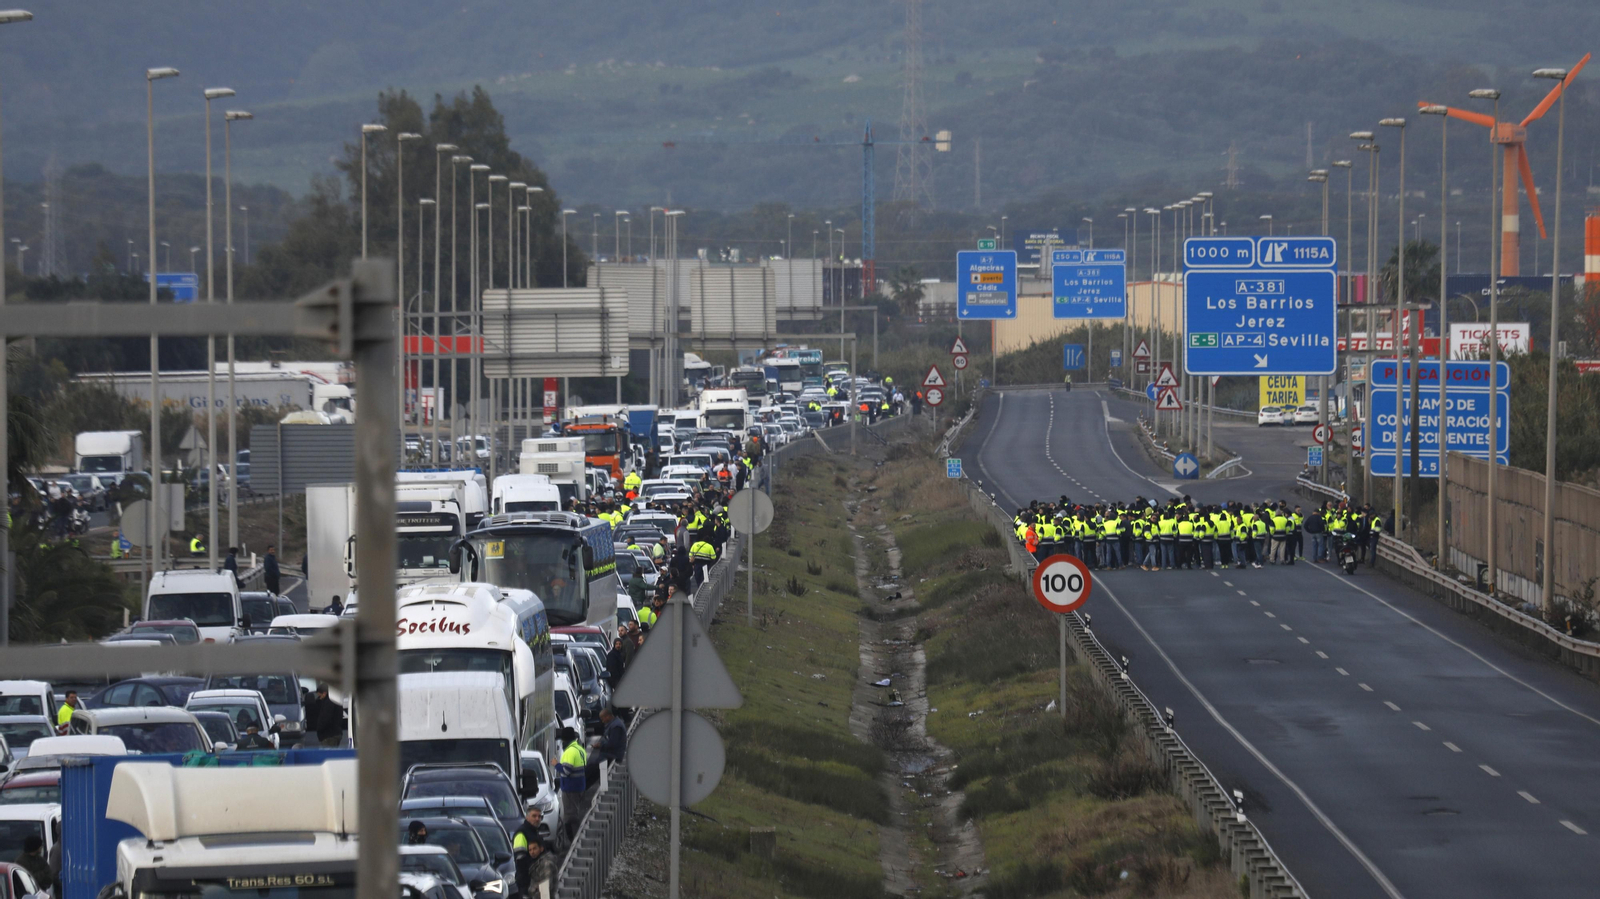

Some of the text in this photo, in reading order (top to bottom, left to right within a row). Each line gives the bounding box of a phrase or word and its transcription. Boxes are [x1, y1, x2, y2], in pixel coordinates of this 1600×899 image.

[1190, 247, 1249, 258] 1000 m
[1294, 247, 1329, 259] 1115A
[970, 264, 1004, 273] Algeciras
[1238, 281, 1284, 293] A-381
[1093, 296, 1122, 304] Sevilla
[1206, 296, 1314, 310] Los Barrios
[1235, 315, 1285, 328] Jerez
[1191, 333, 1330, 347] E-5 AP-4 Sevilla
[1460, 343, 1508, 353] FERY
[1384, 366, 1493, 381] PCACIÓN
[1267, 375, 1298, 389] CEUTA
[188, 396, 224, 408] Gio
[1267, 391, 1299, 404] TARIFA
[1403, 398, 1476, 411] TAMO DE
[1377, 414, 1502, 428] CONENRACIÓN
[1404, 431, 1493, 445] ACCIENTES
[1042, 573, 1083, 593] 100
[227, 875, 291, 888] Trans.Res
[295, 875, 314, 885] 60
